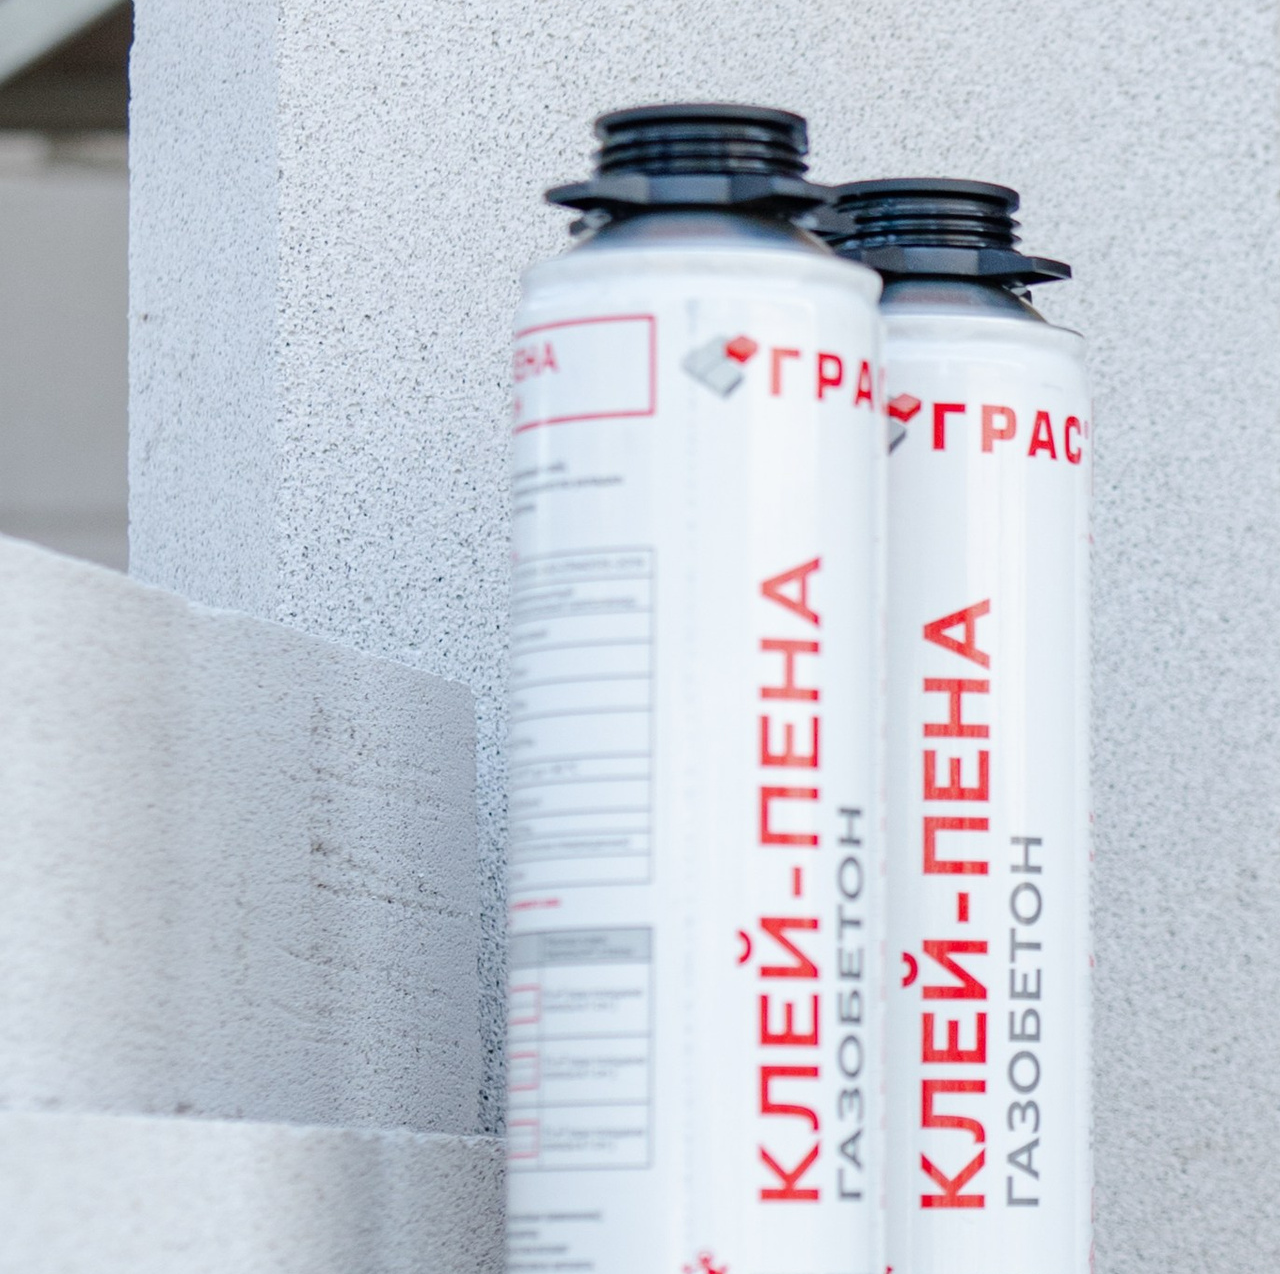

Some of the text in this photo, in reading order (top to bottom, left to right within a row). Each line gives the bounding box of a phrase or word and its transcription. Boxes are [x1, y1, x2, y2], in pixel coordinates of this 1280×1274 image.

[769, 347, 884, 415] ГРА
[931, 401, 1084, 466] ГРАС
[738, 557, 822, 1202] КЛЕЙ-ПЕНА
[837, 806, 864, 1202] ГАЗОБЕТОН
[901, 597, 991, 1210] КЛЕЙ-ПЕНА
[1006, 835, 1043, 1208] ГАЗОБЕТОН
